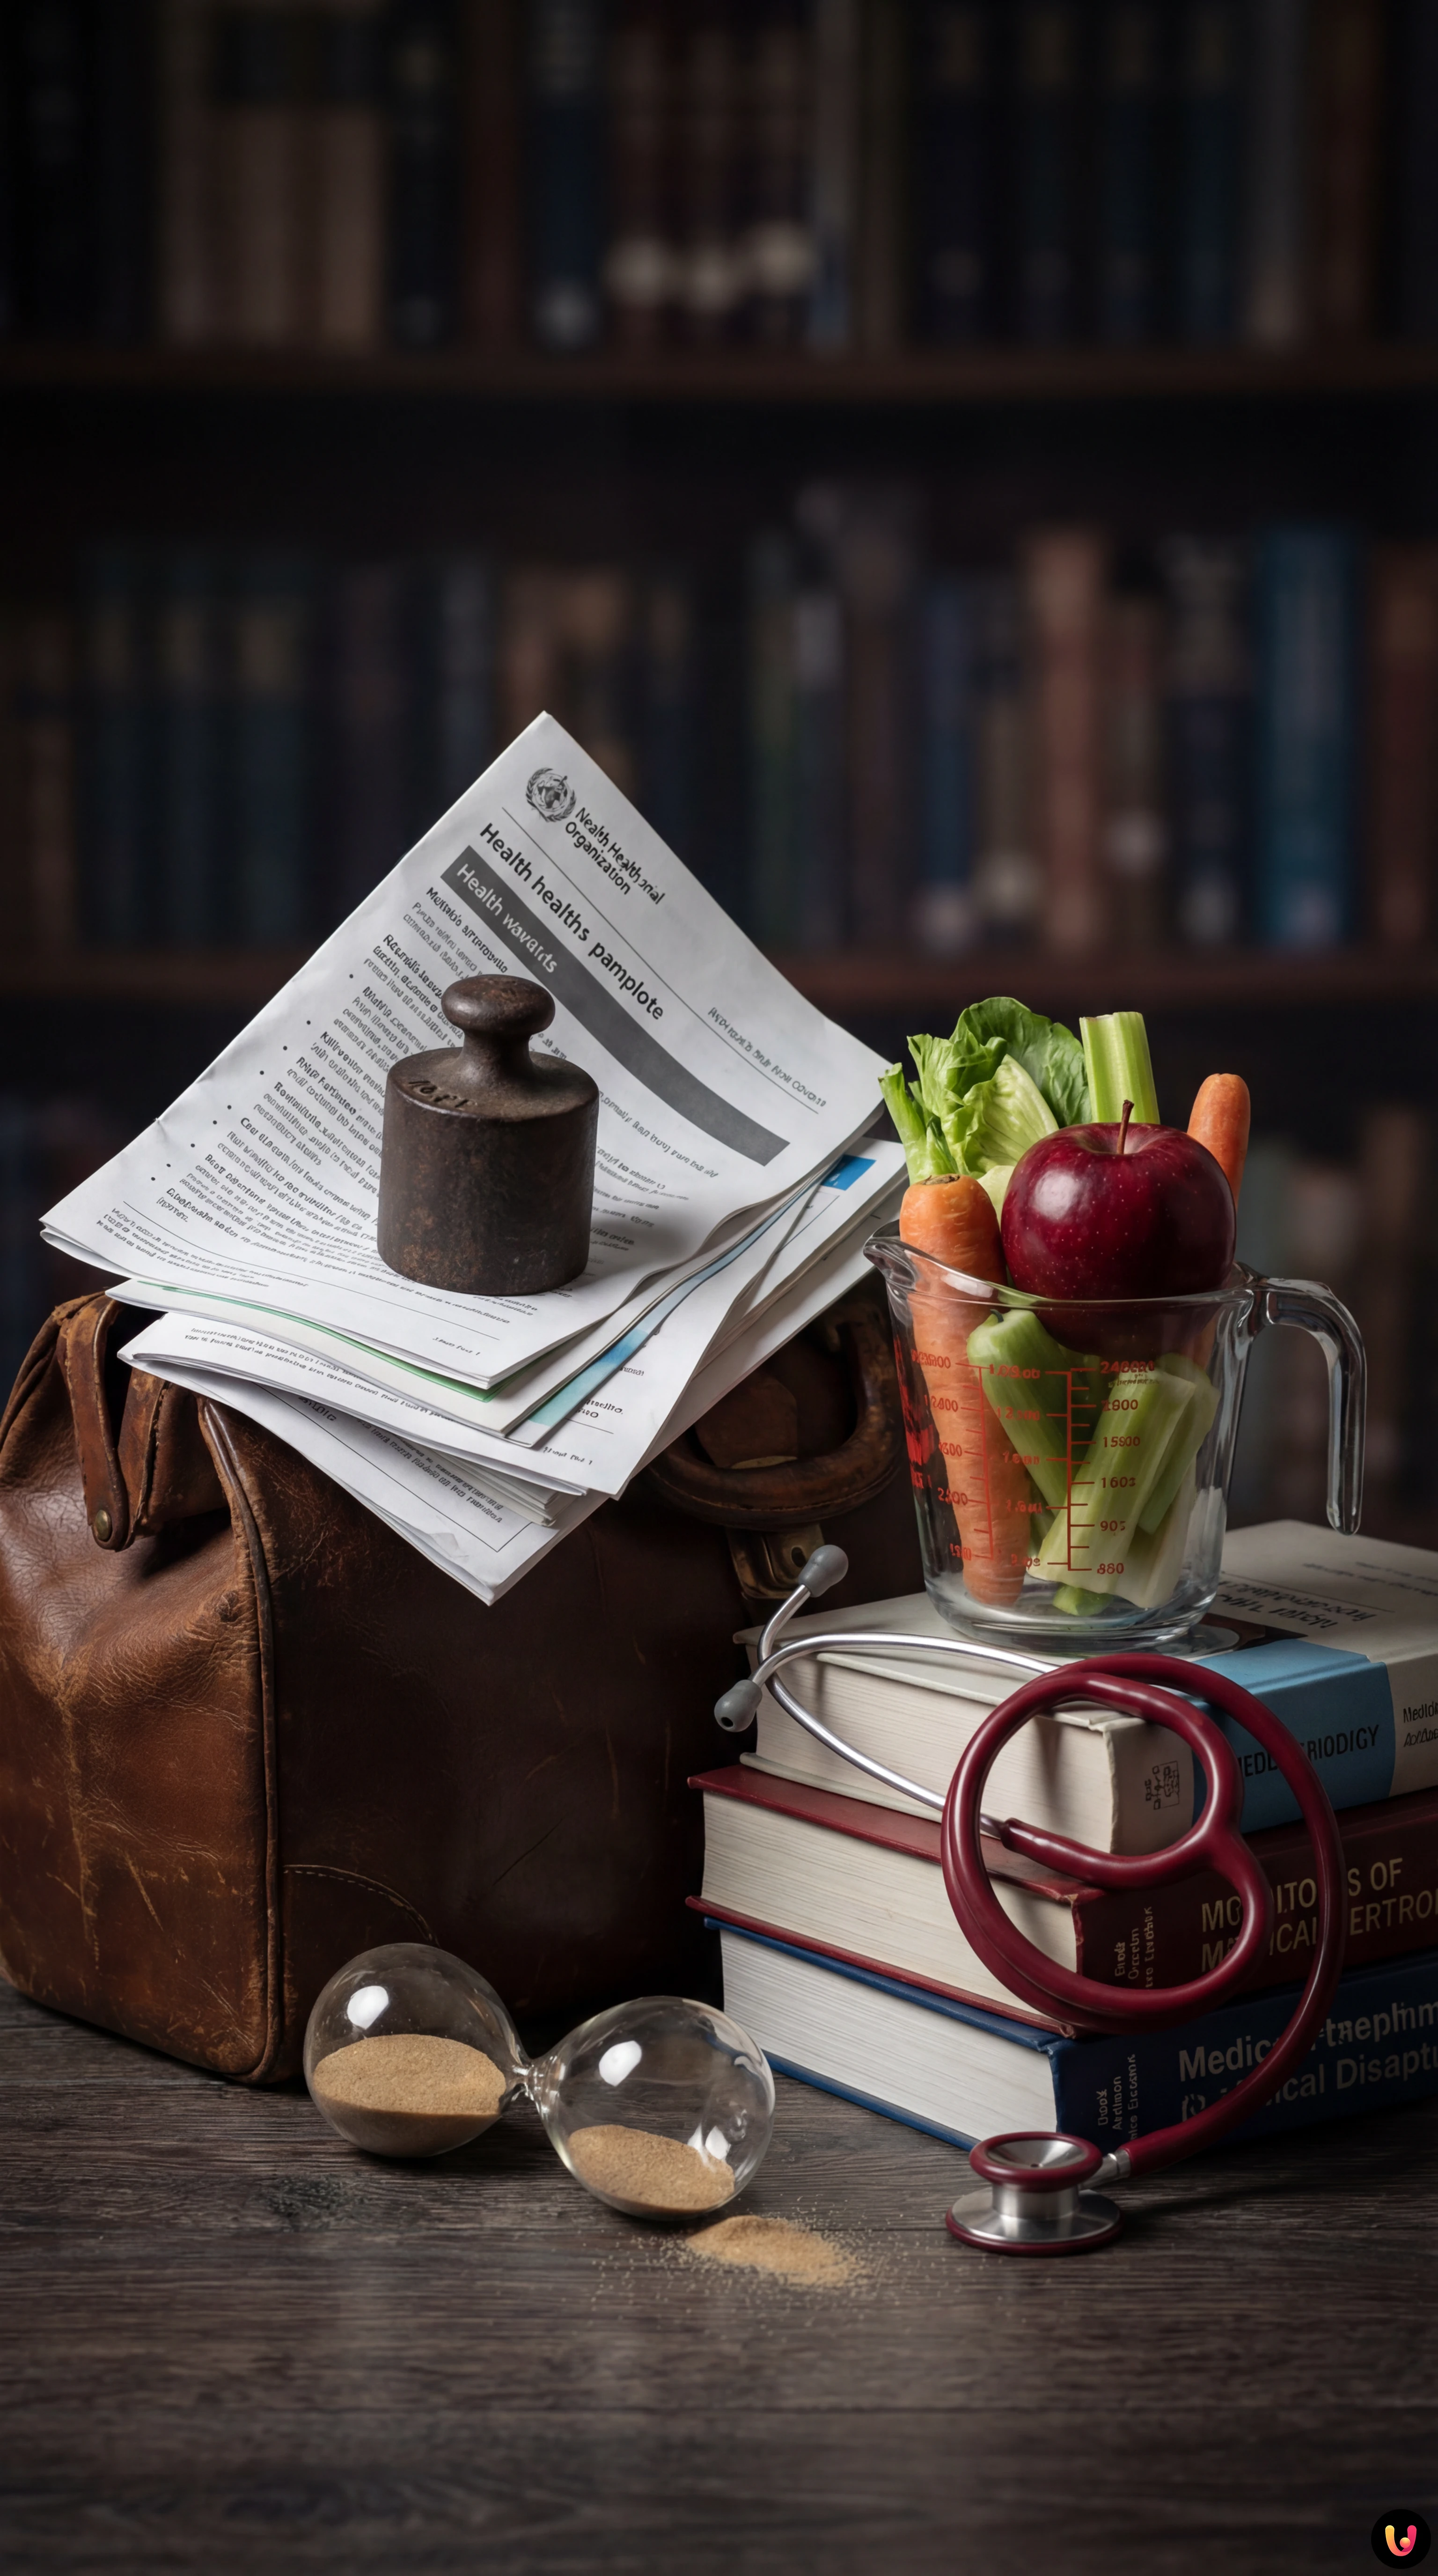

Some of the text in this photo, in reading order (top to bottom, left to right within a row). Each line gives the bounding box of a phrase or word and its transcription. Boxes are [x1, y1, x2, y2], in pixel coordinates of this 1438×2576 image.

[456, 864, 503, 916] Health
[565, 821, 631, 895] Organization
[480, 823, 533, 882] Health
[531, 875, 590, 942] healths
[588, 942, 664, 1020] pamplote
[1201, 1858, 1403, 1933] MOITOS OF
